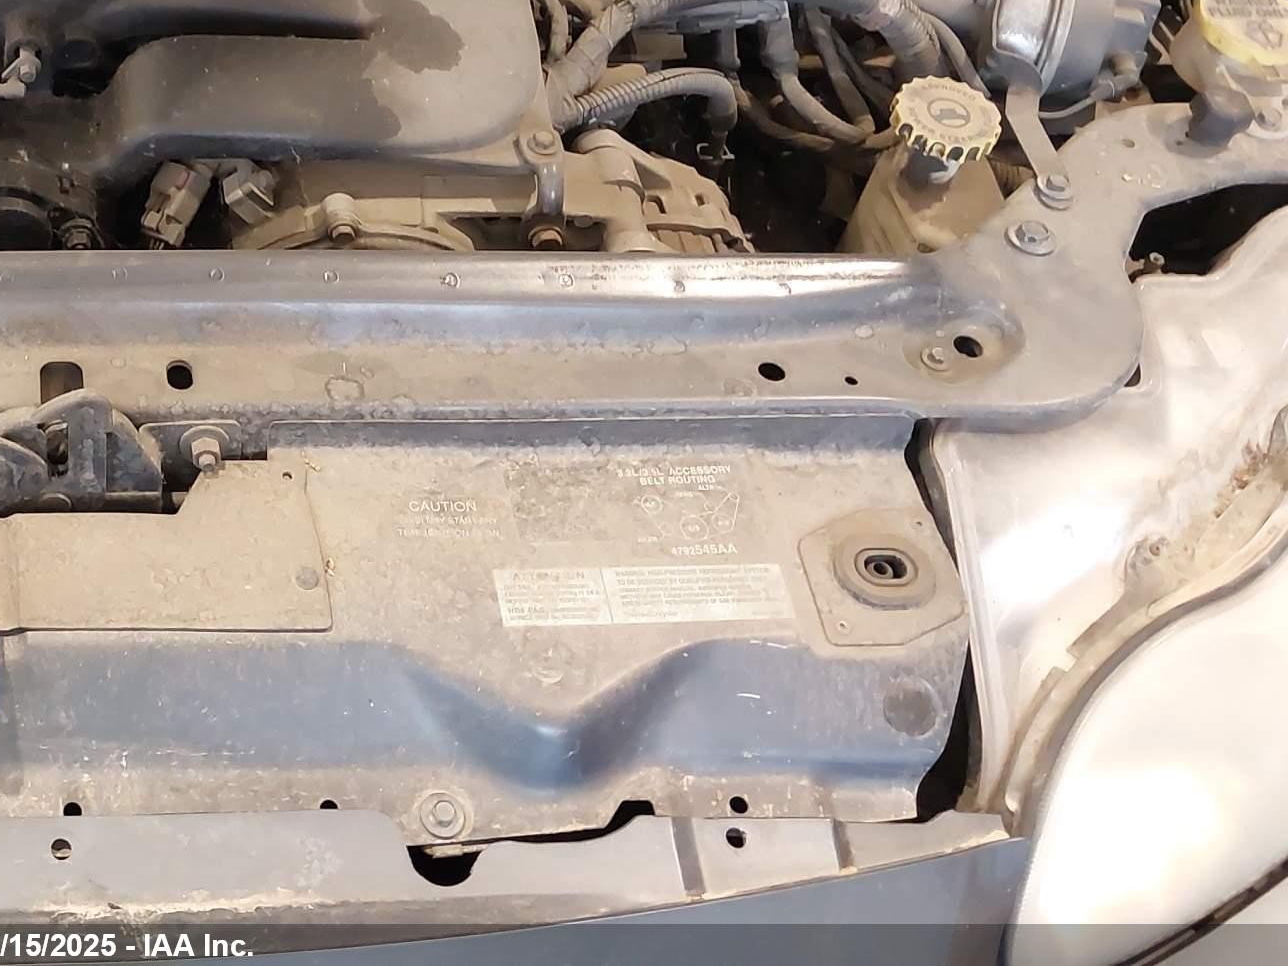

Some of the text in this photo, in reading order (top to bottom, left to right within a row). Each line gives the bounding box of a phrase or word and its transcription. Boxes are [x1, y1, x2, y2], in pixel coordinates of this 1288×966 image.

[669, 465, 732, 476] ACCESSORY
[639, 474, 717, 486] BELT ROUTING
[408, 499, 478, 513] CAUTION
